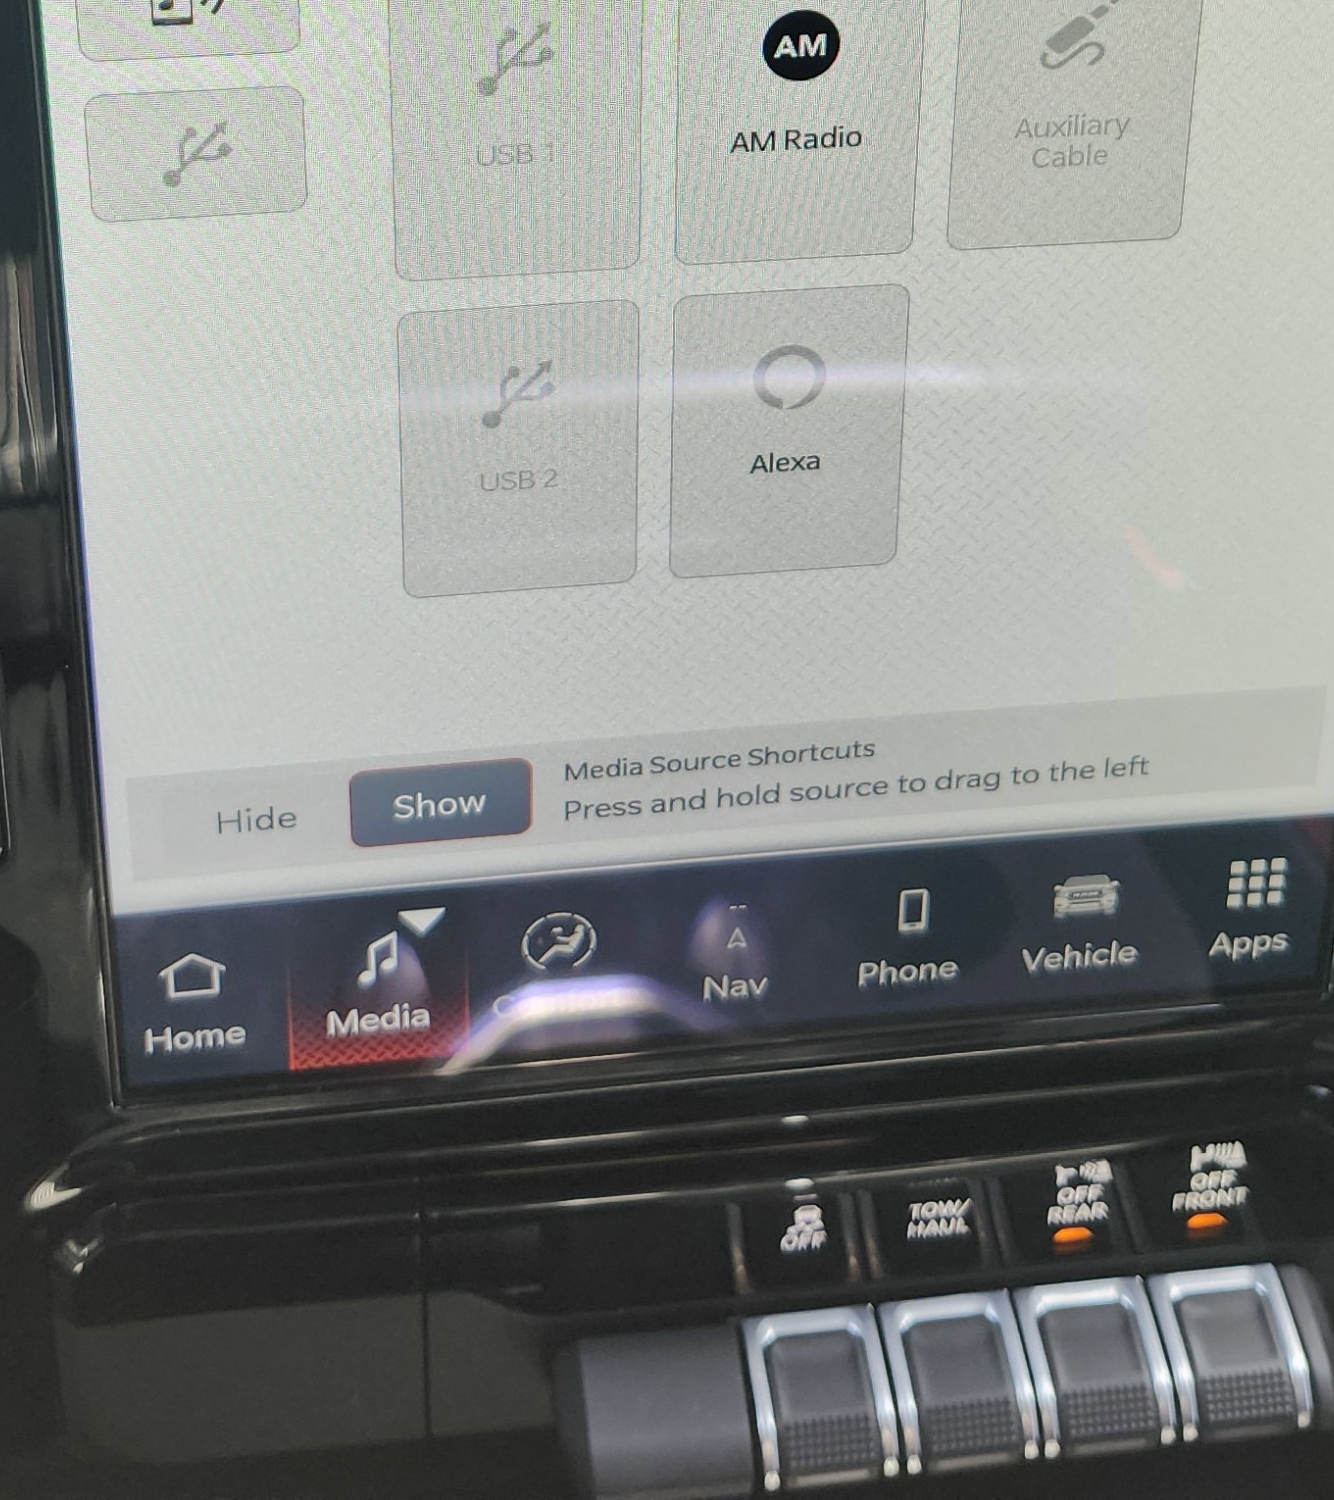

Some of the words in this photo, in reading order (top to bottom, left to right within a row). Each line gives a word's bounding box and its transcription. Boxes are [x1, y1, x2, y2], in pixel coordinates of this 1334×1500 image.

[773, 32, 828, 59] AM
[730, 130, 777, 153] AM
[784, 126, 863, 150] Radio
[1015, 113, 1131, 142] Auxiliary
[476, 143, 533, 166] USB
[1032, 143, 1108, 168] Cable
[750, 451, 821, 475] Alexa
[480, 470, 537, 492] USB
[542, 468, 559, 490] 2
[565, 757, 644, 783] Media
[650, 750, 742, 776] Source
[748, 739, 876, 767] Shortcuts
[564, 796, 642, 822] Press
[650, 789, 707, 815] and
[714, 782, 781, 810] hold
[790, 777, 889, 802] source
[897, 773, 927, 794] to
[934, 764, 1001, 795] drag
[1011, 765, 1040, 785] to
[1045, 758, 1096, 783] the
[1103, 753, 1151, 779] left
[393, 791, 487, 821] Show
[216, 807, 298, 835] Hide
[1021, 940, 1139, 974] Vehicle
[1208, 930, 1291, 961] Apps
[858, 959, 959, 988] Phone
[703, 974, 768, 1002] Nav
[326, 1003, 432, 1038] Media
[144, 1022, 247, 1055] Home
[1190, 1169, 1242, 1192] OFF
[1056, 1184, 1106, 1206] OFF
[1172, 1187, 1251, 1212] FRONT
[1047, 1201, 1112, 1226] REAR
[780, 1230, 828, 1253] OFF
[906, 1218, 971, 1240] HAUL
